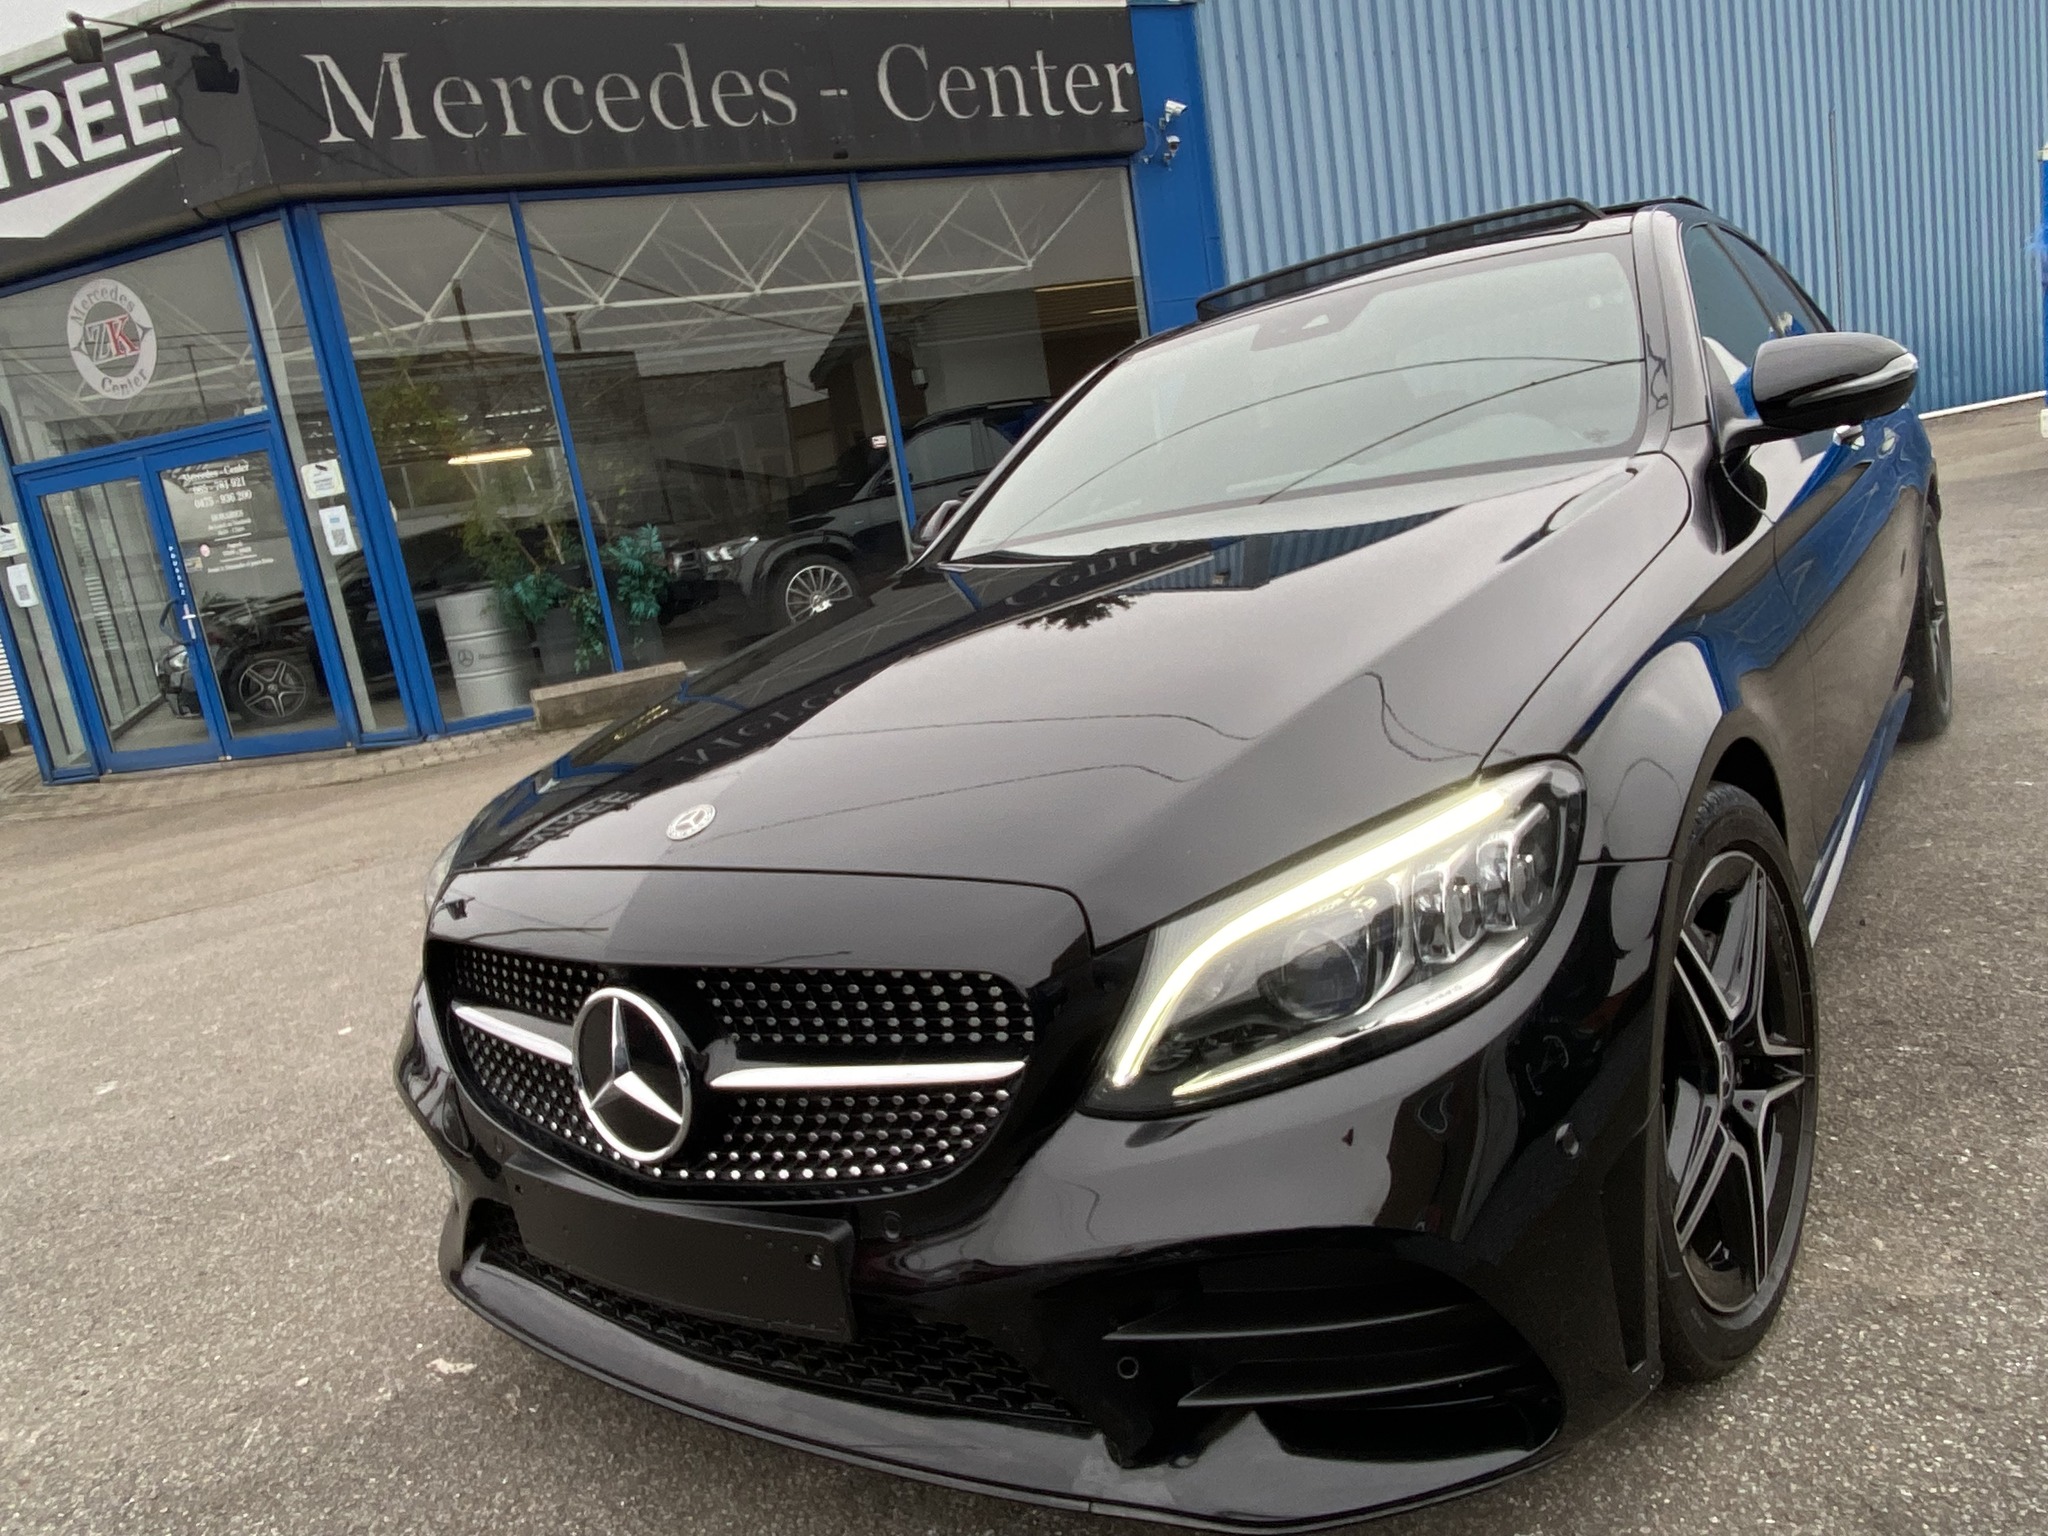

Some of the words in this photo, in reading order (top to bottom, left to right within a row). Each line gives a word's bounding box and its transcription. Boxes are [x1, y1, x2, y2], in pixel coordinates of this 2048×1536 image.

[301, 42, 797, 143] Mercedes
[820, 87, 848, 96] -
[878, 43, 1134, 121] Center
[71, 285, 135, 322] Mercedes
[85, 314, 141, 366] ZK
[101, 369, 146, 396] Center
